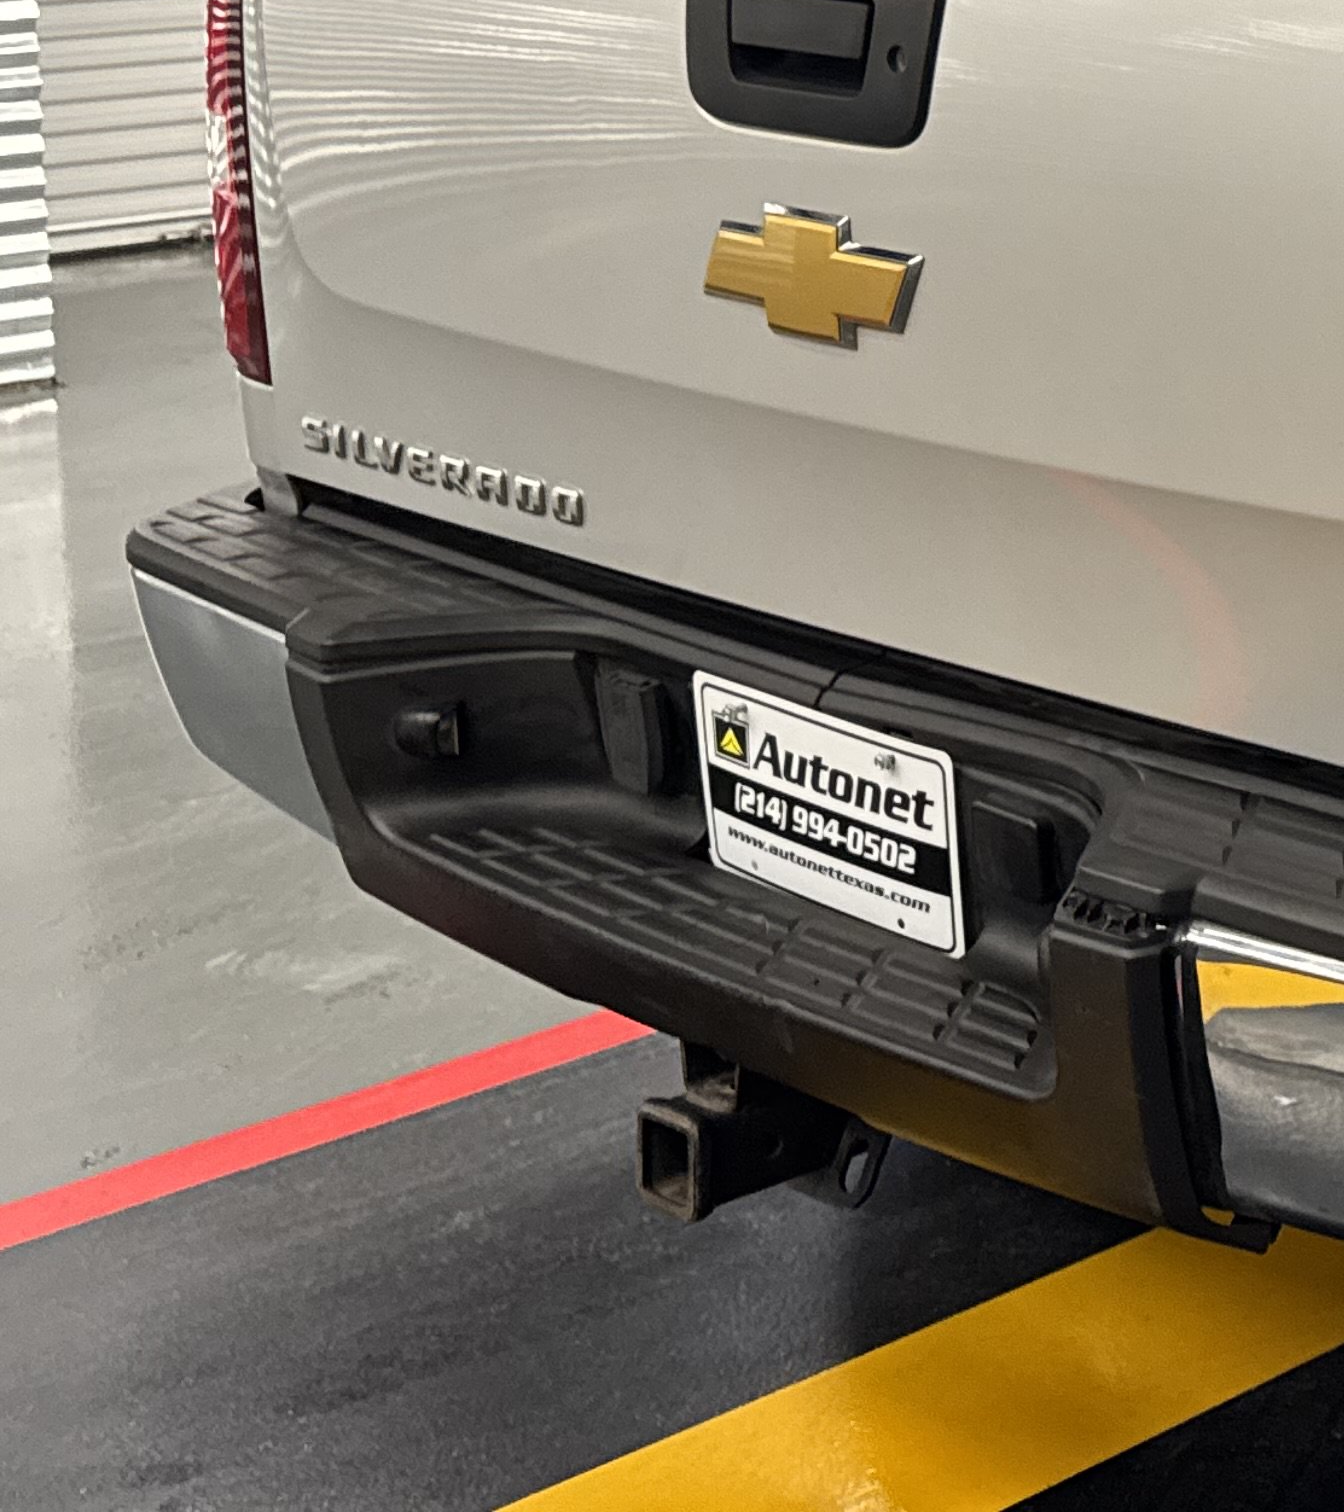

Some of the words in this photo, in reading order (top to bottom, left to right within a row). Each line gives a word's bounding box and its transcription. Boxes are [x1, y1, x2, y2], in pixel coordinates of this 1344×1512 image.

[300, 414, 586, 527] SILVERADO
[733, 781, 789, 832] (214)
[792, 805, 917, 875] 994-0502
[753, 732, 935, 832] Autonet
[727, 824, 932, 915] www.autonettexas.com
